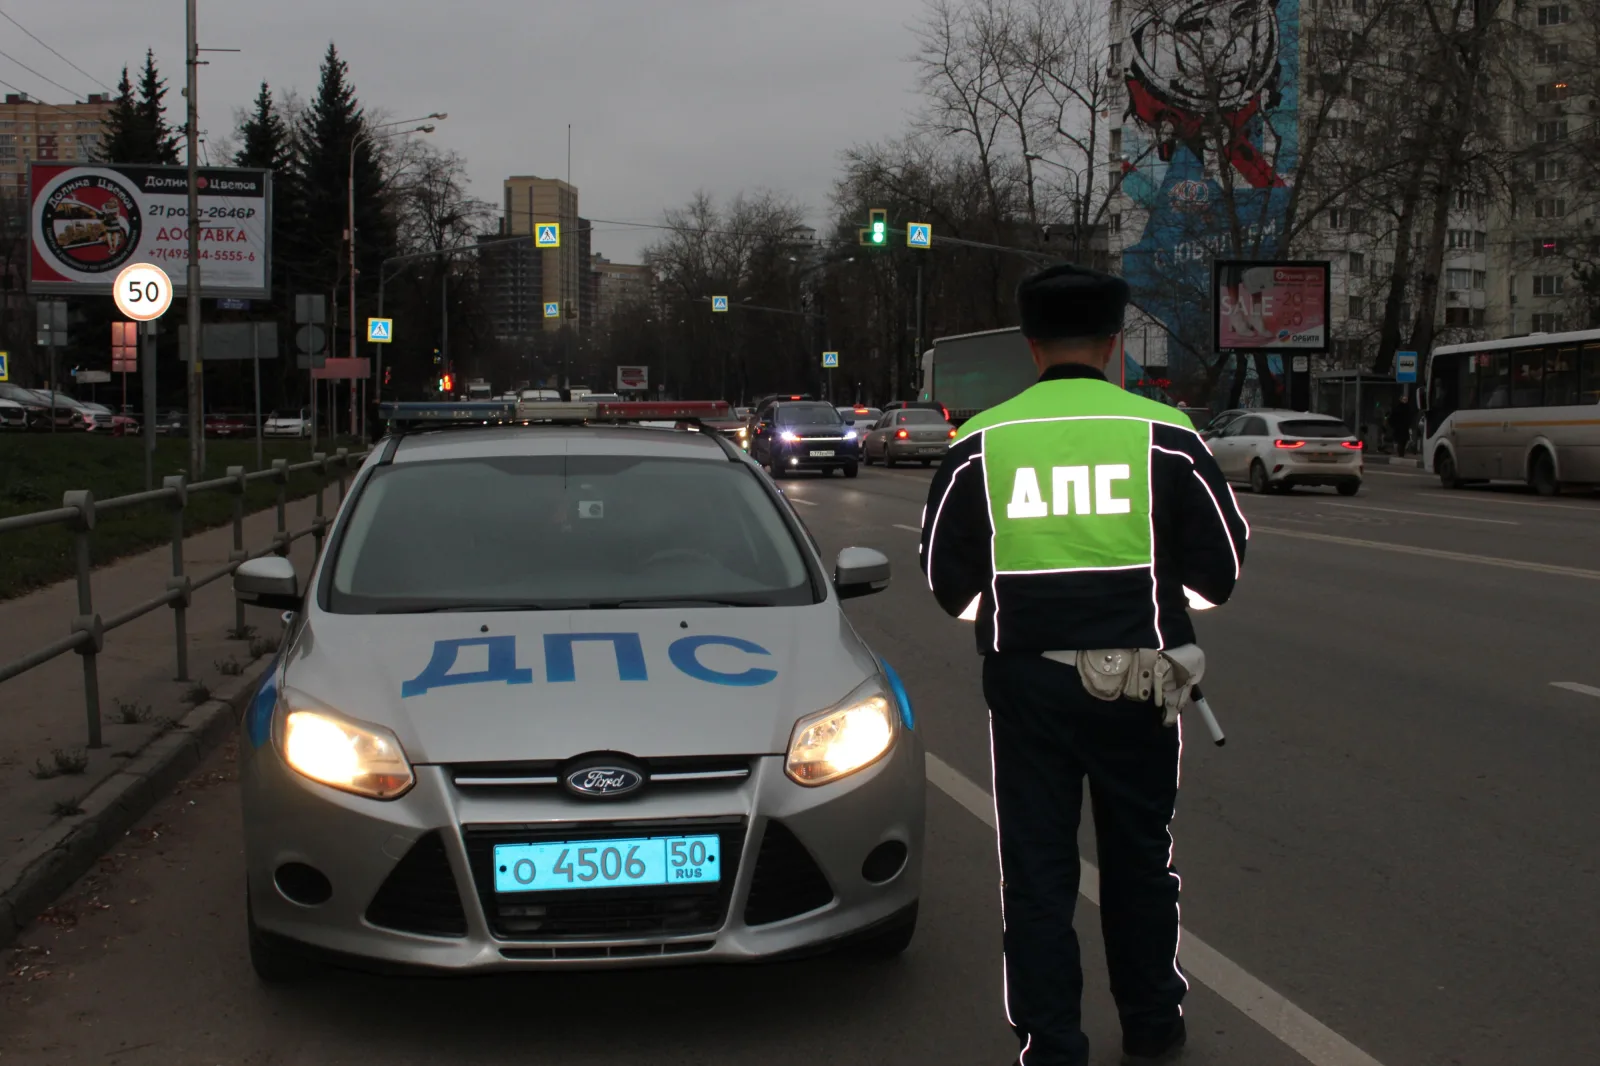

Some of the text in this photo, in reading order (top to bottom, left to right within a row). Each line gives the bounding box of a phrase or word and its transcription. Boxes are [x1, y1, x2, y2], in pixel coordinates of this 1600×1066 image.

[48, 178, 133, 210] Долина Цветов
[210, 179, 256, 190] Цветов
[148, 205, 164, 216] 21
[129, 281, 159, 302] 50
[1221, 295, 1274, 316] SALE
[1007, 464, 1130, 519] ДПС
[402, 632, 778, 698] ДПС
[584, 770, 625, 788] Ford
[553, 845, 646, 882] 4506
[671, 840, 706, 867] 50
[675, 868, 702, 879] RUS
